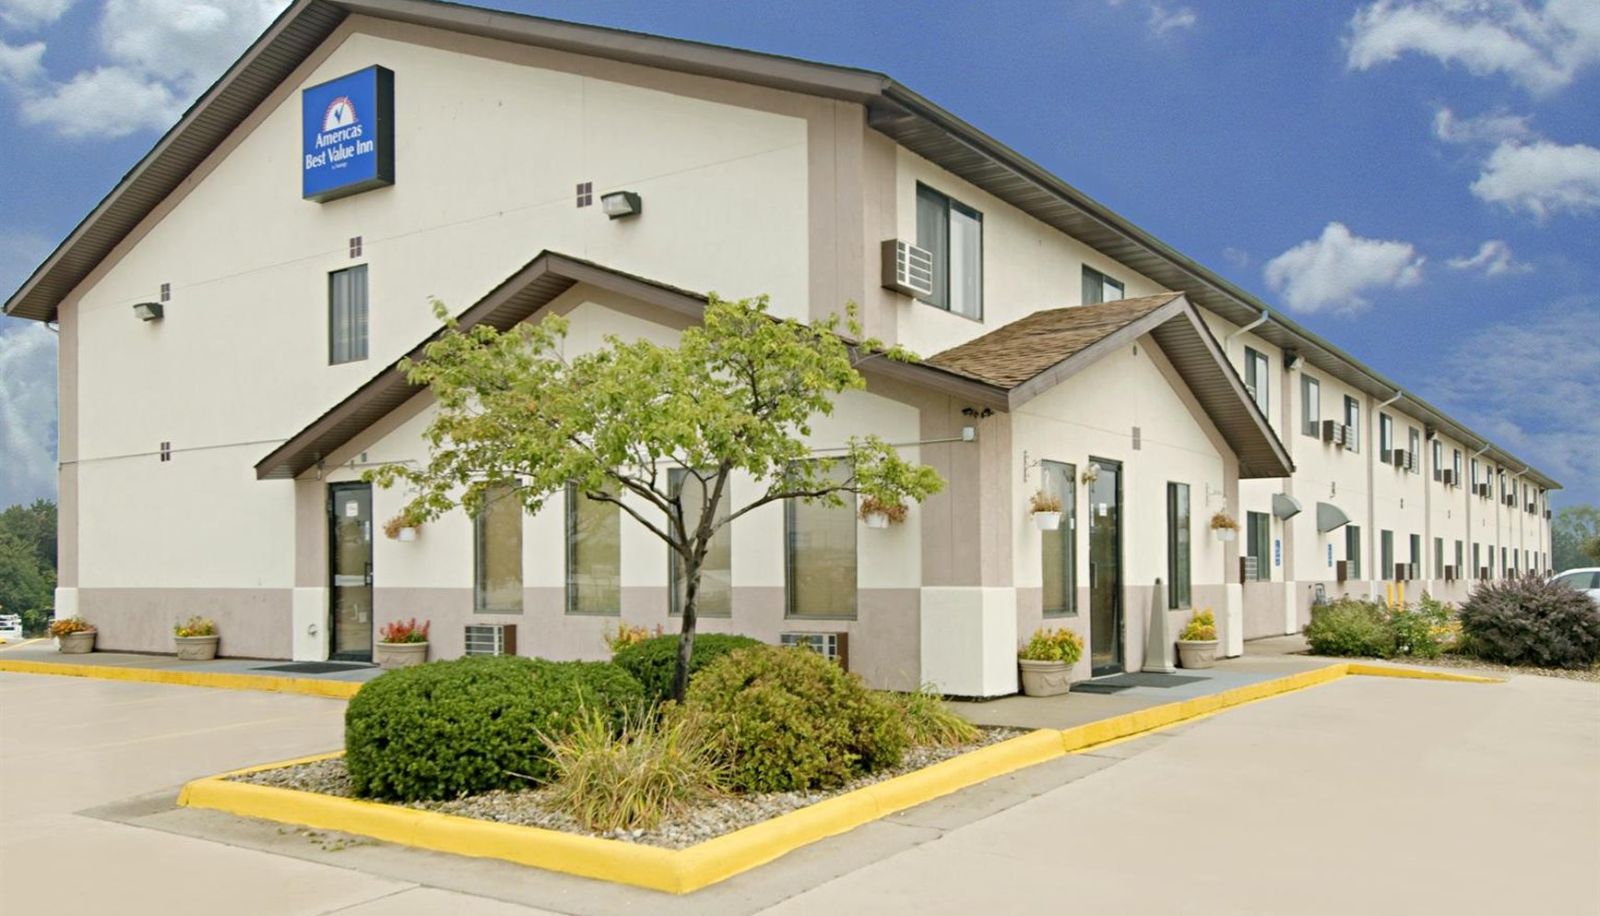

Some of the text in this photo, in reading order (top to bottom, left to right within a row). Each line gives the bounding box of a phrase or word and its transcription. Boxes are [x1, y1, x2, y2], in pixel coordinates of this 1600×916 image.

[315, 125, 363, 149] Americas
[305, 151, 326, 170] Best
[327, 144, 354, 162] Value
[356, 140, 373, 155] Inn
